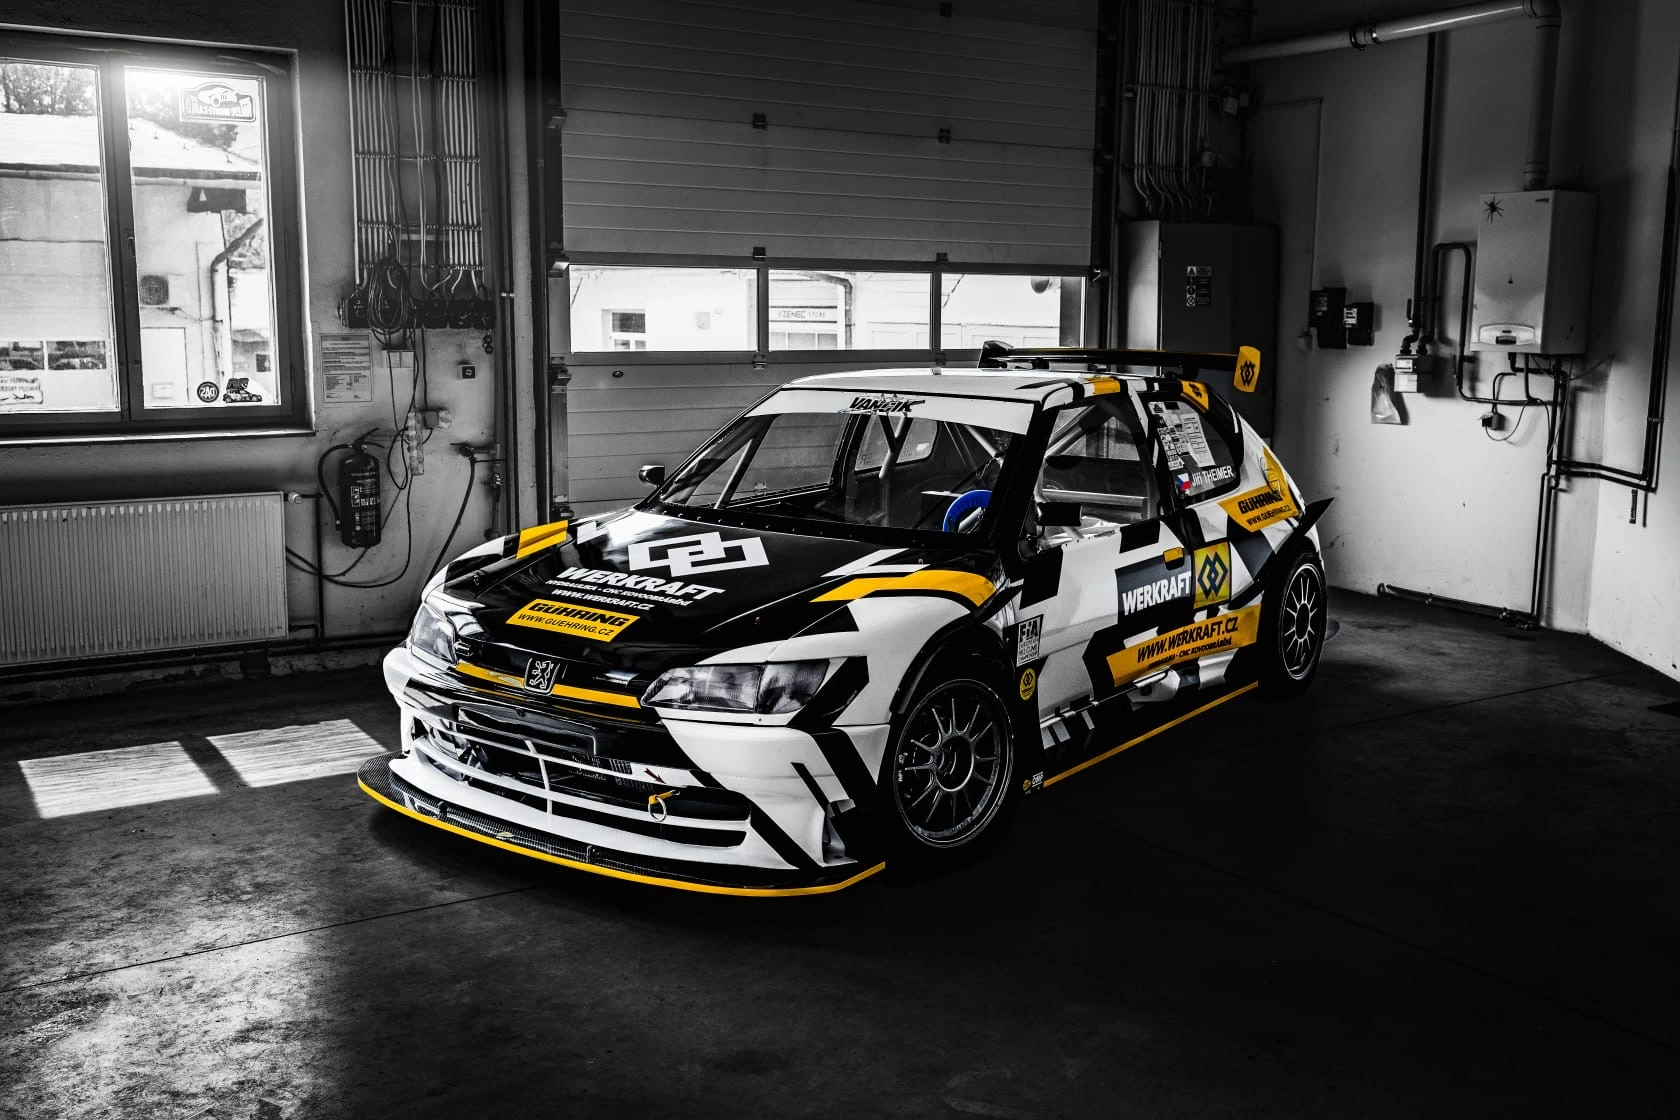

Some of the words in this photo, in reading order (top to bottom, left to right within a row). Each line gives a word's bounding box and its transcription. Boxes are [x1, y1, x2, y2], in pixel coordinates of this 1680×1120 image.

[1202, 465, 1234, 484] THEIMER
[556, 566, 726, 600] WERKRAFT
[1122, 570, 1192, 616] WERKRAFT
[551, 589, 656, 611] WWW.WERKRAFT.CZ
[518, 613, 614, 636] WWW.GUEHRING.CZ
[528, 602, 630, 627] GÜHRING
[1020, 619, 1038, 643] FIA
[1137, 616, 1239, 663] WWW.WERKRAFT.CZ
